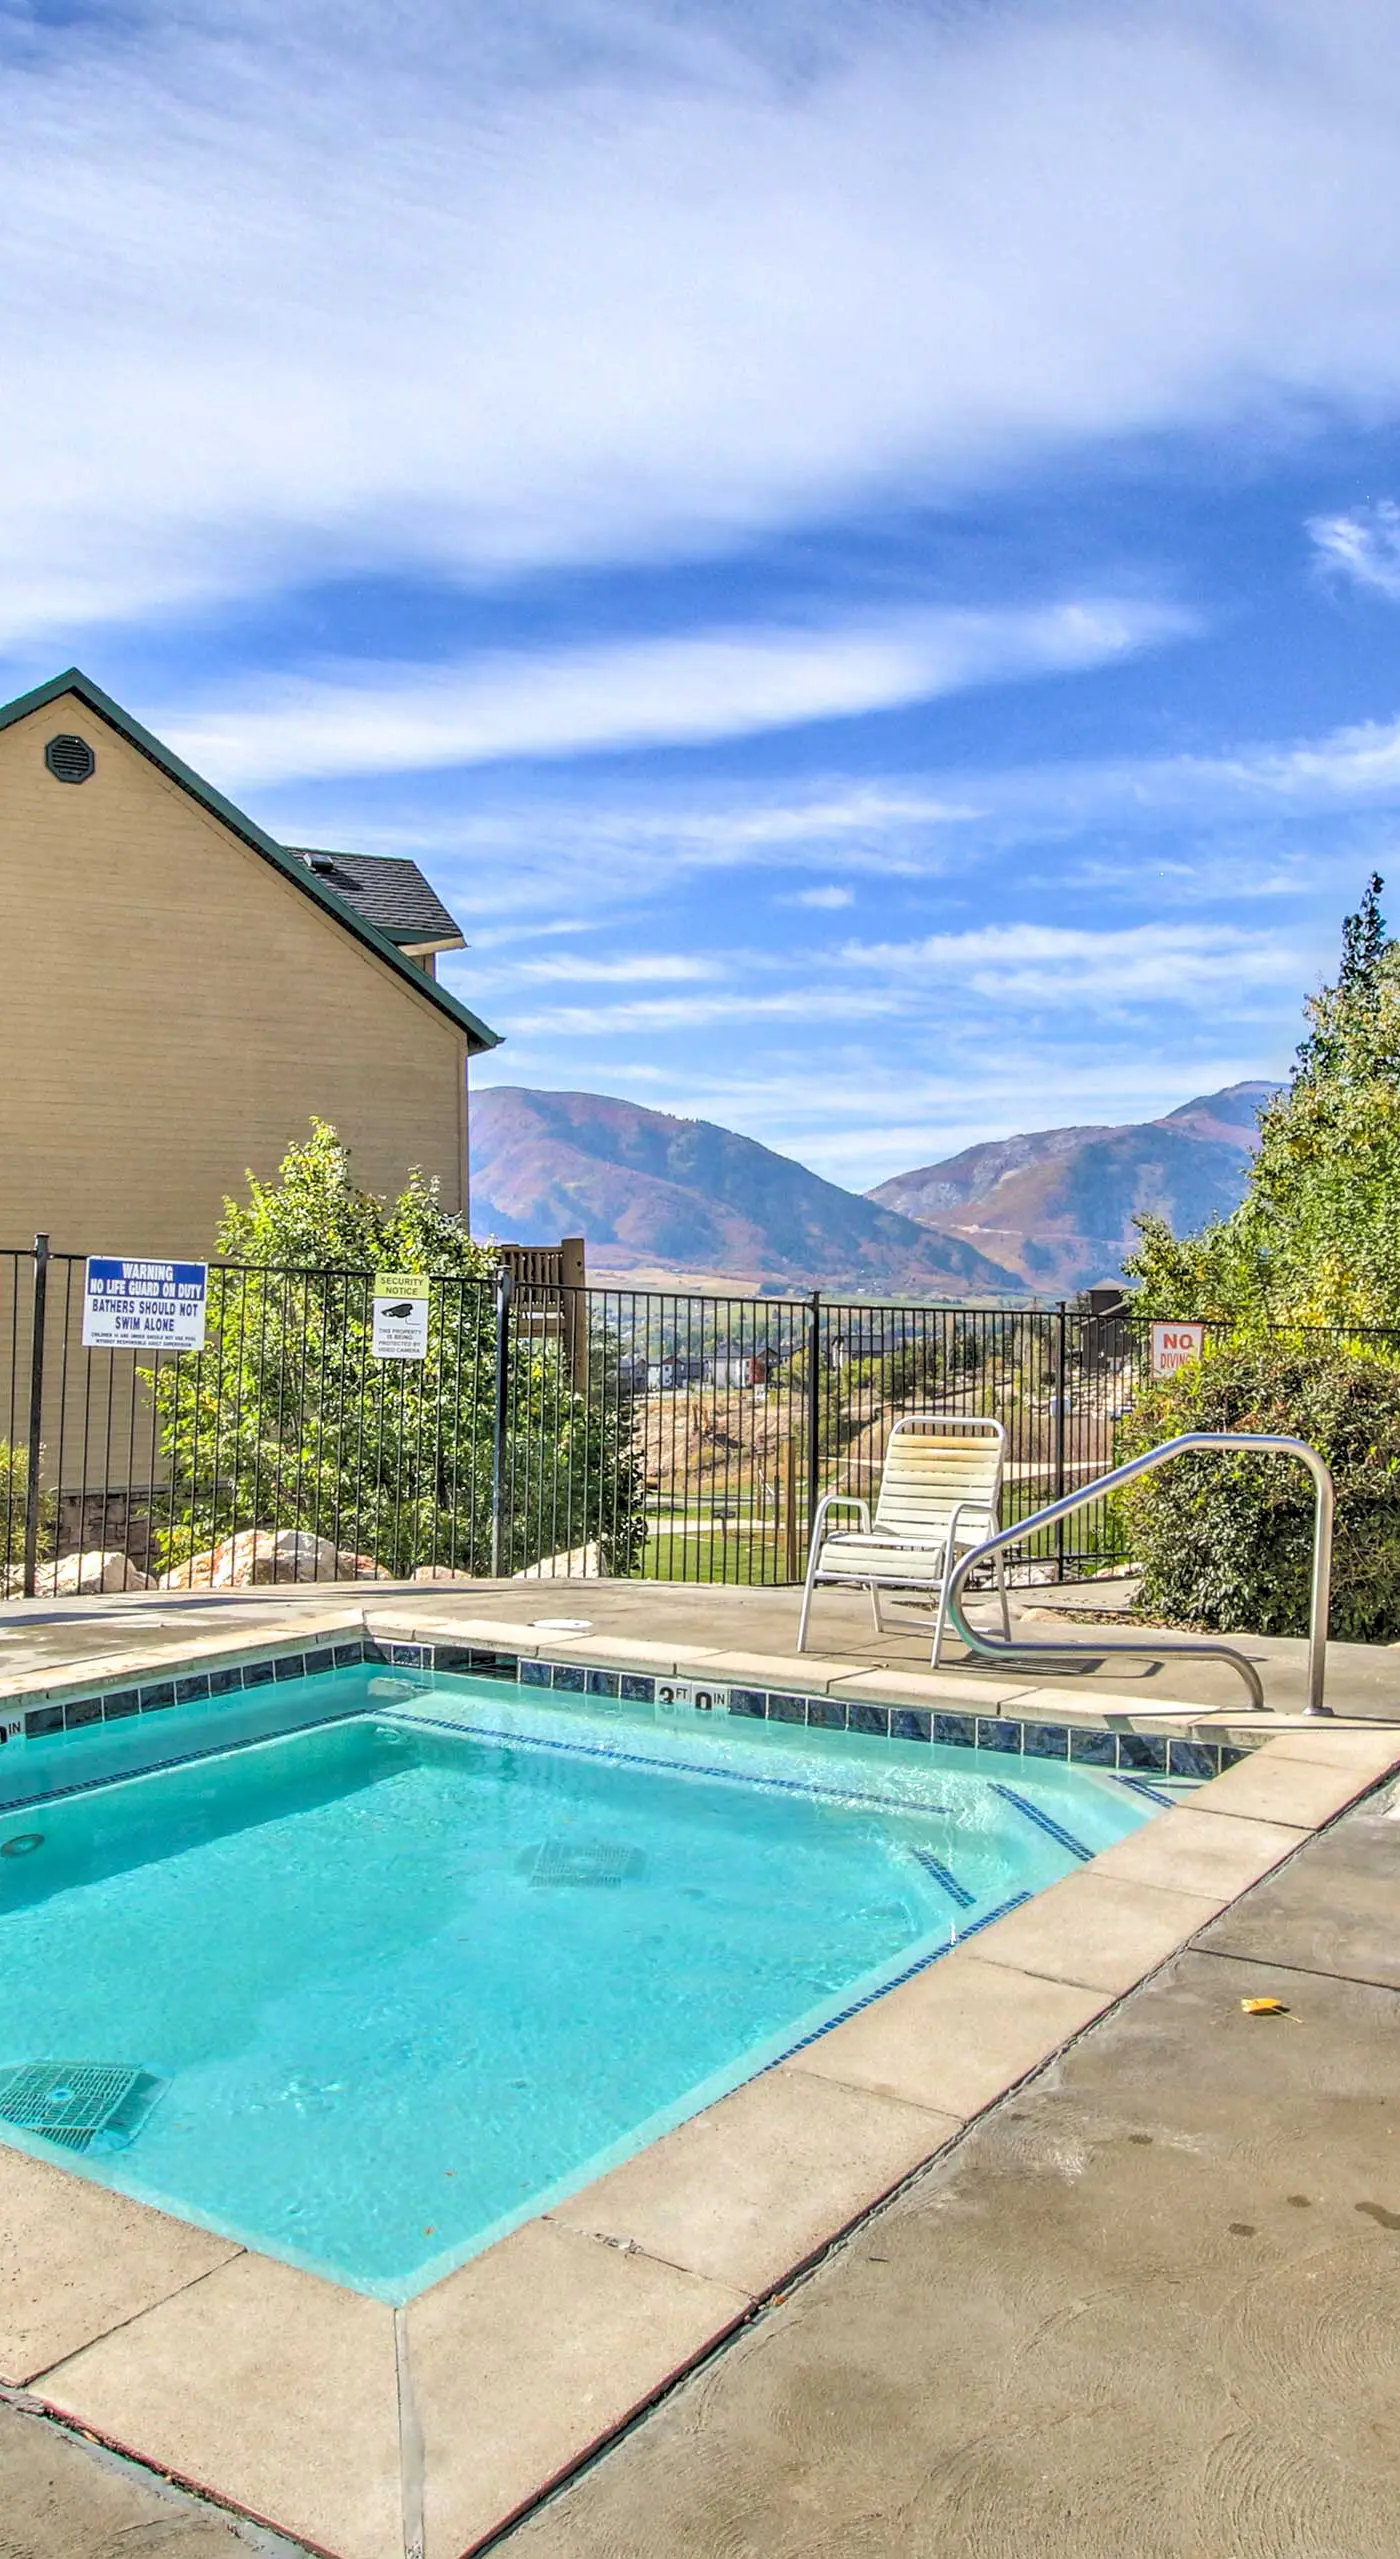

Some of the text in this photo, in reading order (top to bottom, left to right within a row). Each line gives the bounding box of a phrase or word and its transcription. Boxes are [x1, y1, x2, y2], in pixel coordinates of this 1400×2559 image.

[122, 1263, 173, 1281] WARNING
[90, 1278, 202, 1299] NO LIFE GUARD ON DUTY
[380, 1277, 424, 1286] SECURITY
[386, 1287, 418, 1295] NOTICE
[92, 1299, 198, 1317] BATHERS SHOULD NOT
[115, 1317, 175, 1332] SWIM ALONE
[1163, 1333, 1193, 1349] NO
[676, 1688, 688, 1699] FT
[713, 1693, 726, 1705] IN
[8, 1721, 21, 1735] IN
